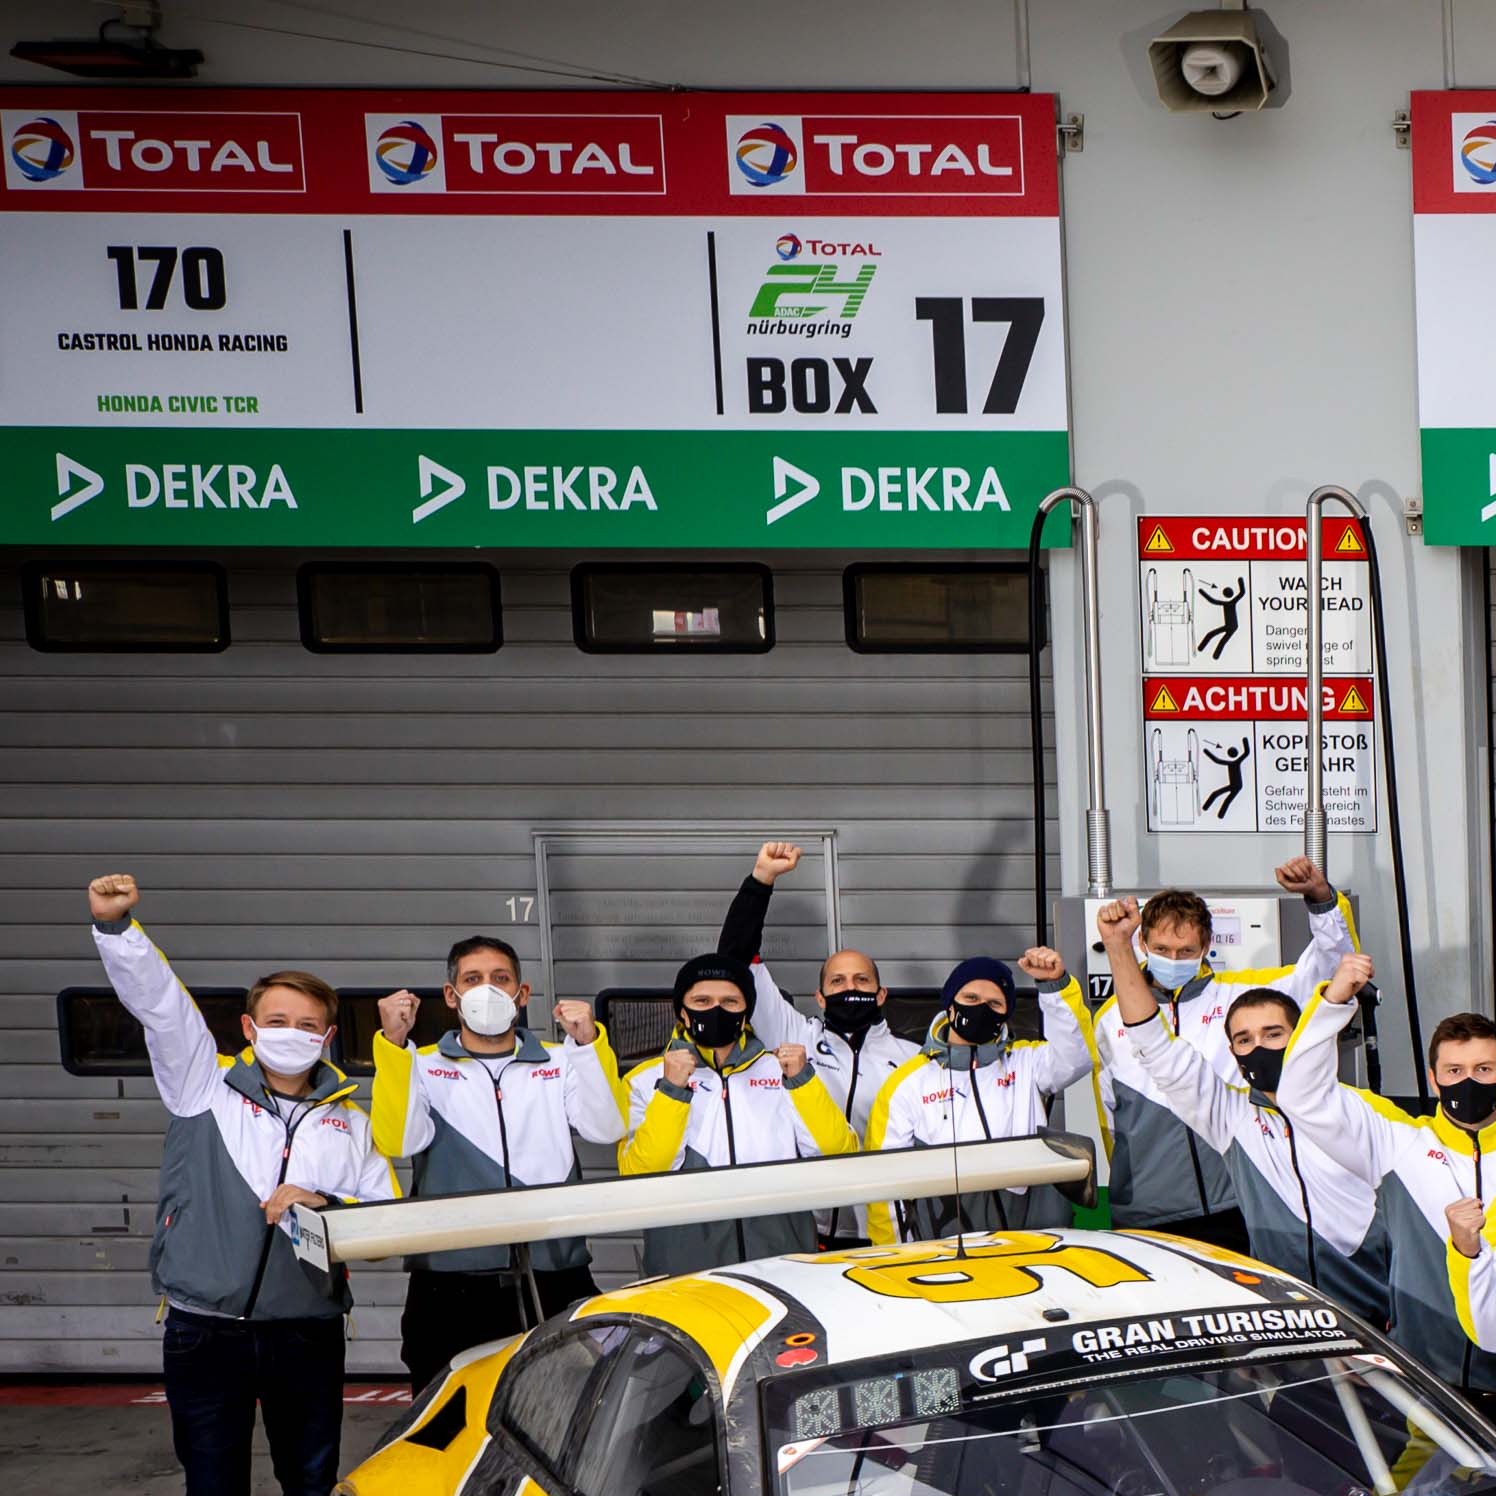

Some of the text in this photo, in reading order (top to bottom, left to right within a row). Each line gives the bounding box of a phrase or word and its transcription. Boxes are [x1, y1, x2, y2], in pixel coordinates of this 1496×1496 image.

[90, 130, 294, 173] TOTAL
[454, 133, 654, 175] TOTAL
[813, 135, 1013, 176] TOTAL
[805, 239, 882, 257] TOTAL
[107, 246, 227, 310] 170
[58, 333, 288, 353] CASTROL HONDA RACING
[747, 320, 852, 339] nürburgring
[915, 296, 1045, 415] 17
[746, 357, 878, 414] BOX
[97, 395, 259, 414] HONDA CIVIC TCR
[125, 463, 299, 509] DEKRA
[487, 465, 658, 511] DEKRA
[841, 466, 1012, 512] DEKRA
[1279, 577, 1342, 591] WACH
[1266, 640, 1302, 650] swivel
[1342, 639, 1353, 650] of
[1266, 655, 1302, 668] spring
[1265, 785, 1369, 797] Gefahr im
[1265, 815, 1287, 826] des
[505, 896, 535, 922] 17
[1090, 977, 1112, 997] 17
[1072, 1307, 1339, 1356] GRAN TURISMO
[1082, 1328, 1347, 1363] THE REAL DRIVING SIMULATOR
